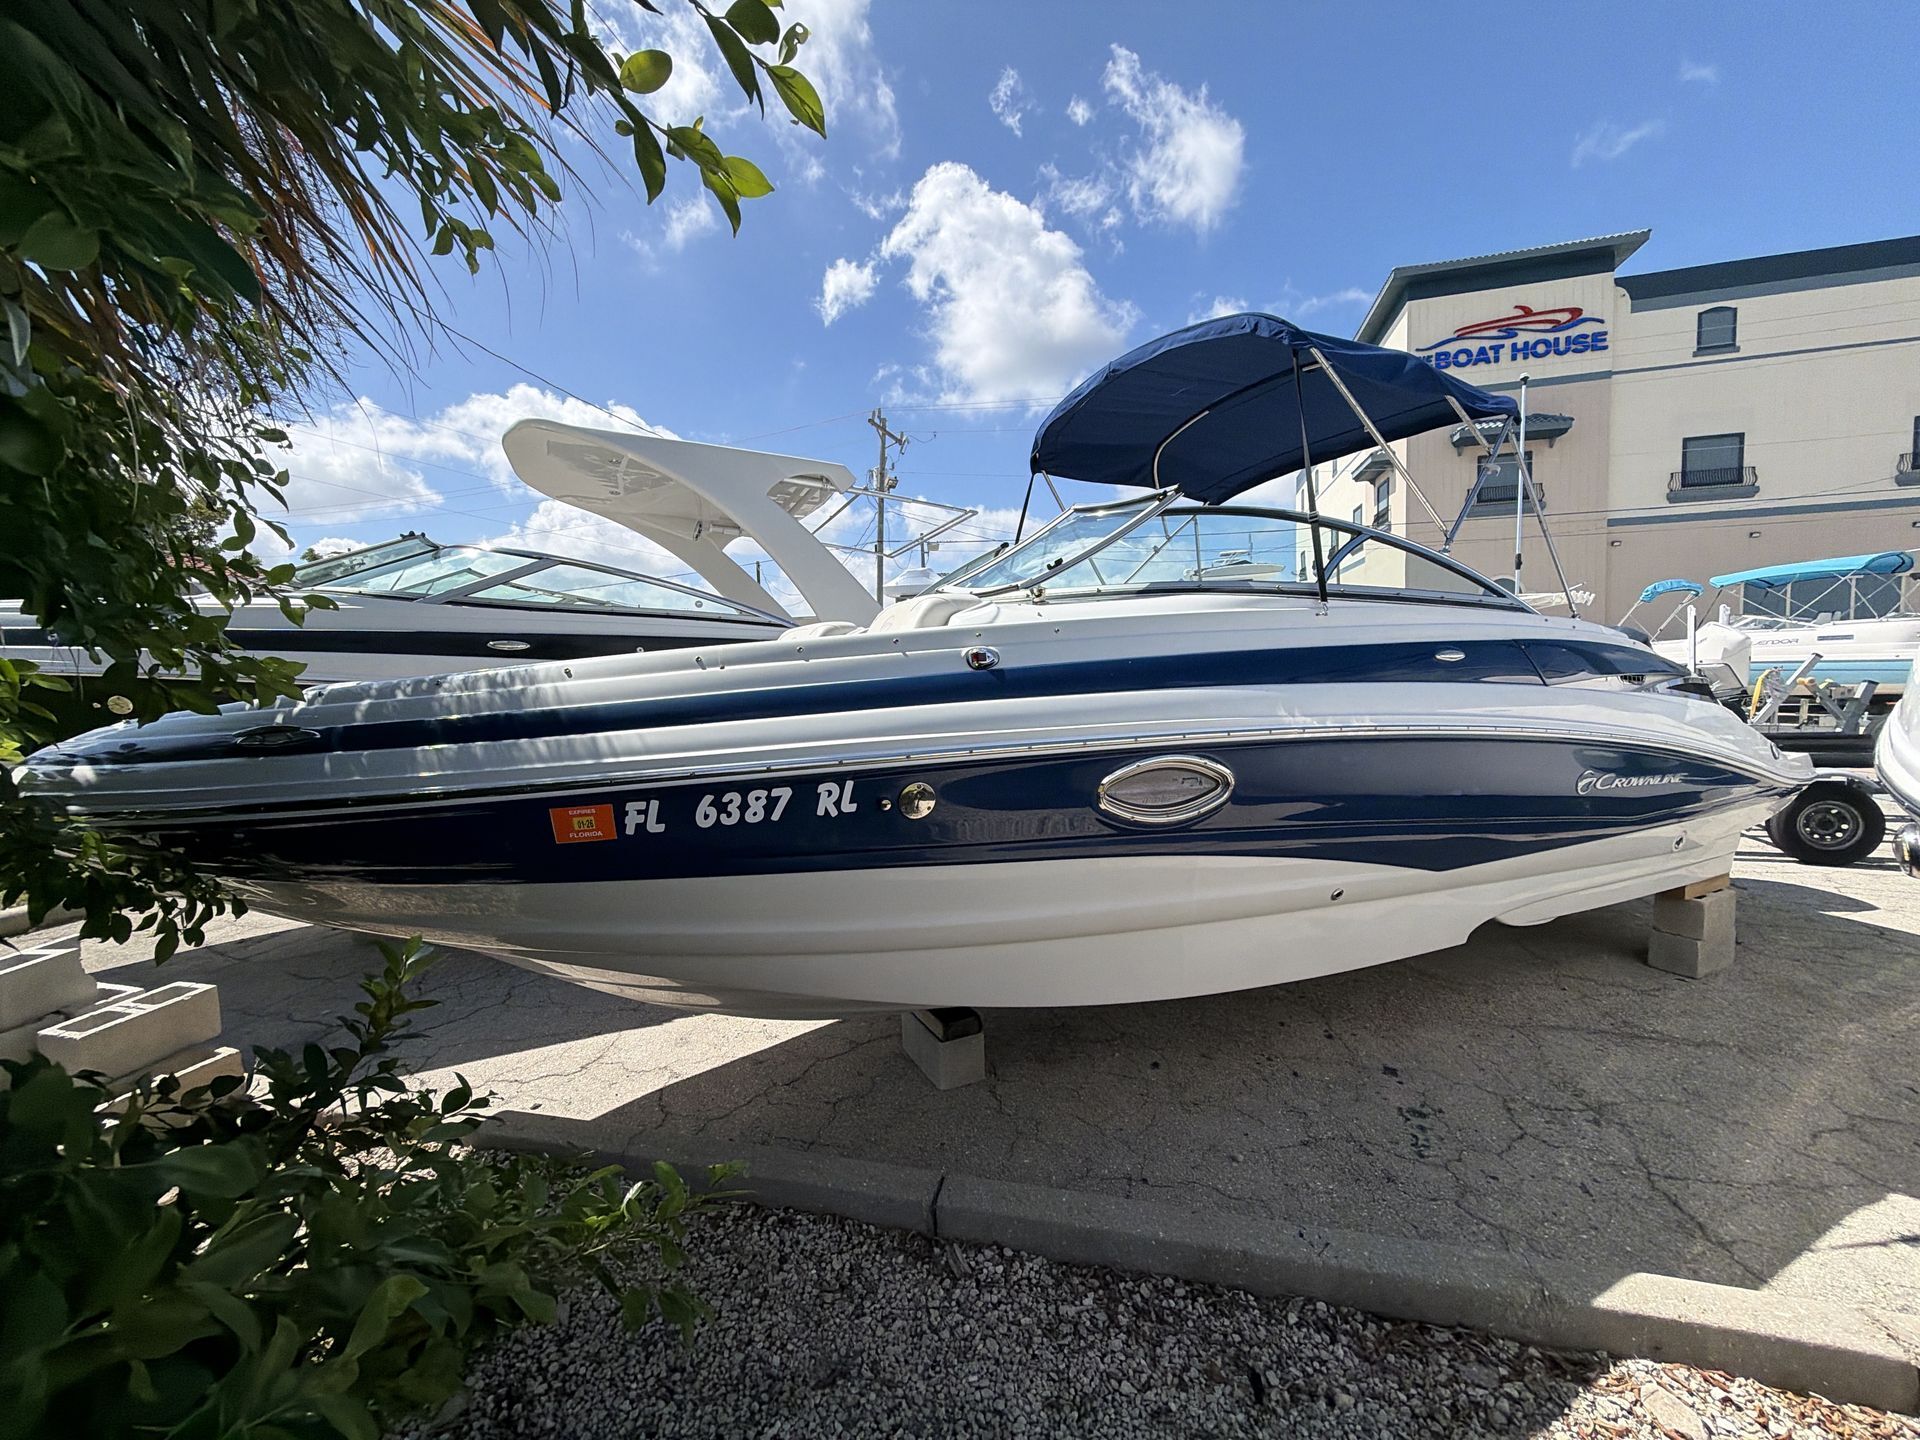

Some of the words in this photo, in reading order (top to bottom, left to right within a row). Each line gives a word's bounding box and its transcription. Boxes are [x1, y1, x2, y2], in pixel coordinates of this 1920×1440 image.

[1435, 344, 1504, 369] BOAT
[1510, 331, 1609, 361] HOUSE
[1595, 772, 1689, 790] CROWNLINE
[568, 808, 596, 816] EXPIRES
[624, 800, 666, 835] FL
[695, 786, 793, 828] 6387
[816, 780, 858, 818] RL
[569, 830, 603, 838] FLORIDA
